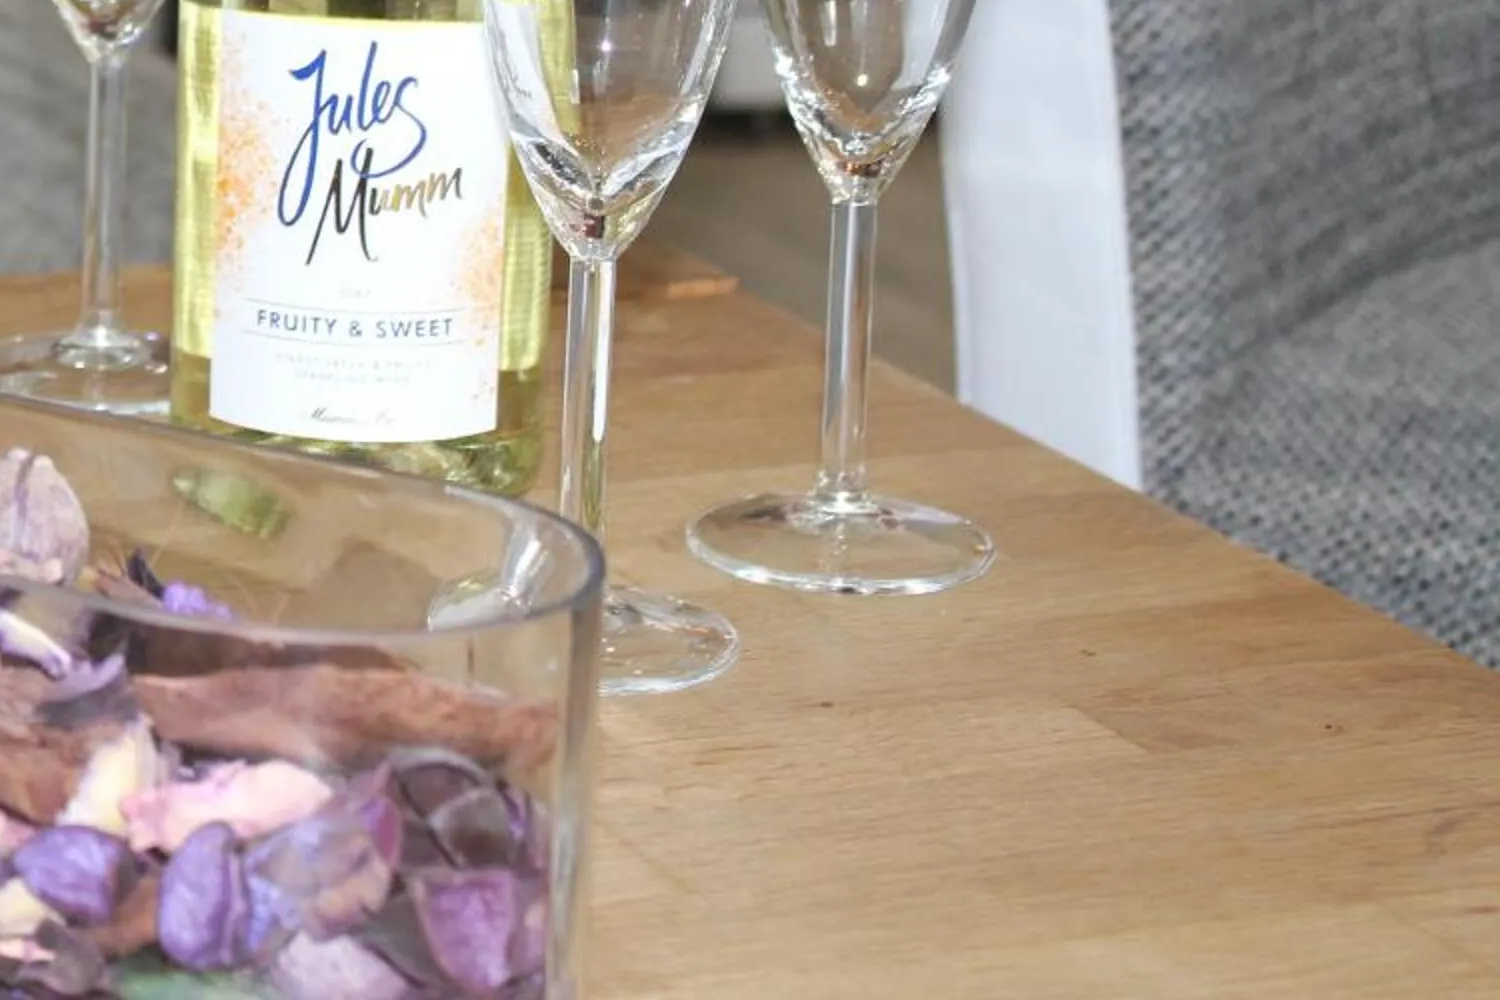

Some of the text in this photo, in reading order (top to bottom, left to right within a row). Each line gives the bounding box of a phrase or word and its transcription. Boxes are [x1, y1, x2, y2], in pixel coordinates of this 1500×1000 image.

[278, 40, 427, 227] Jules
[306, 147, 462, 266] Mumm
[257, 310, 452, 338] FRUITY & SWEET
